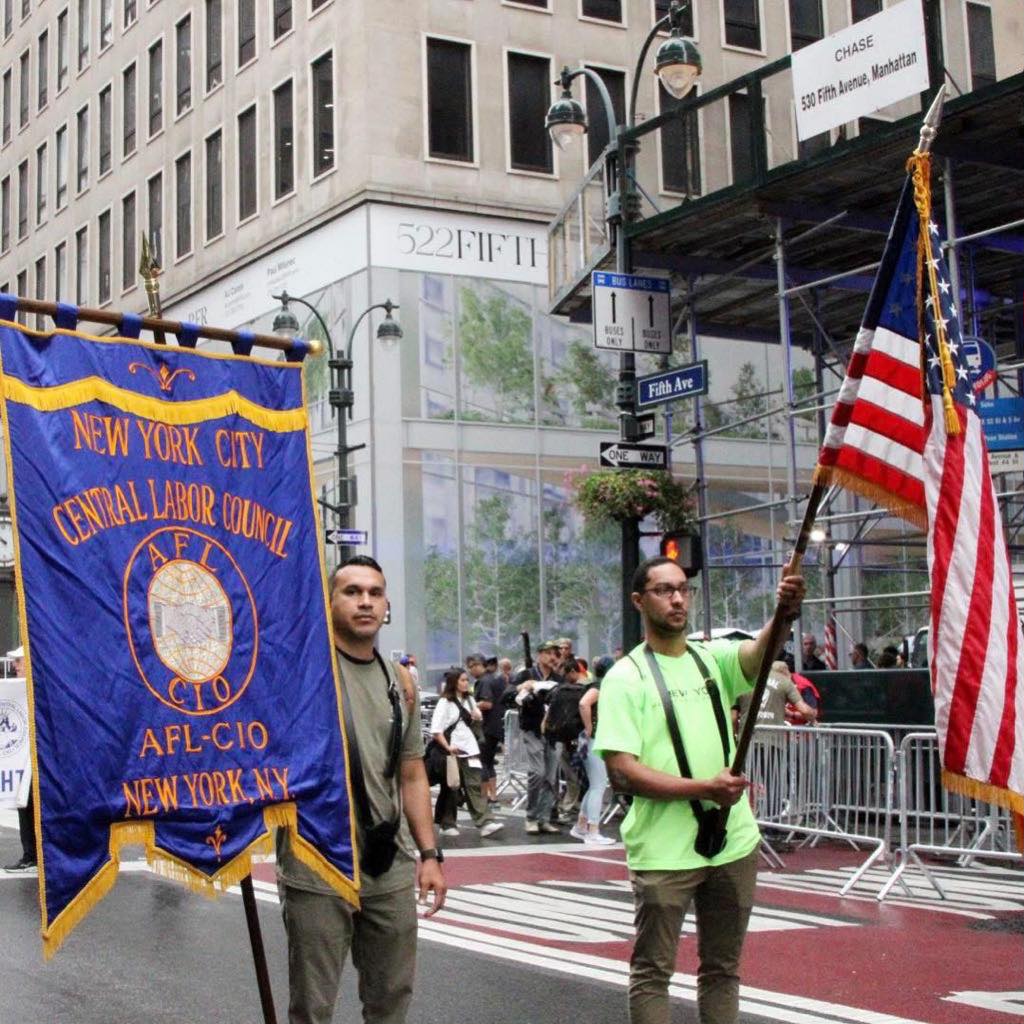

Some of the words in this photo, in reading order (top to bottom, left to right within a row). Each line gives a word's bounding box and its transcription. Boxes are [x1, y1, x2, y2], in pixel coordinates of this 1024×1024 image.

[834, 34, 874, 62] CHASE
[801, 91, 816, 112] 530
[817, 83, 838, 105] Fifth
[838, 72, 871, 97] Avenue,
[871, 50, 917, 82] Manhattan
[611, 275, 627, 288] BUS
[648, 380, 673, 399] Fifth
[674, 375, 694, 394] Ave
[70, 409, 130, 456] NEW
[136, 418, 203, 466] YORK
[215, 428, 265, 469] CITY
[608, 449, 630, 461] ONE
[639, 450, 662, 463] WAY
[52, 480, 148, 547] CENTRAL
[147, 479, 216, 527] LABOR
[221, 491, 293, 559] COUNCIL
[139, 720, 269, 758] AFL-CIO
[122, 775, 179, 818] NEW
